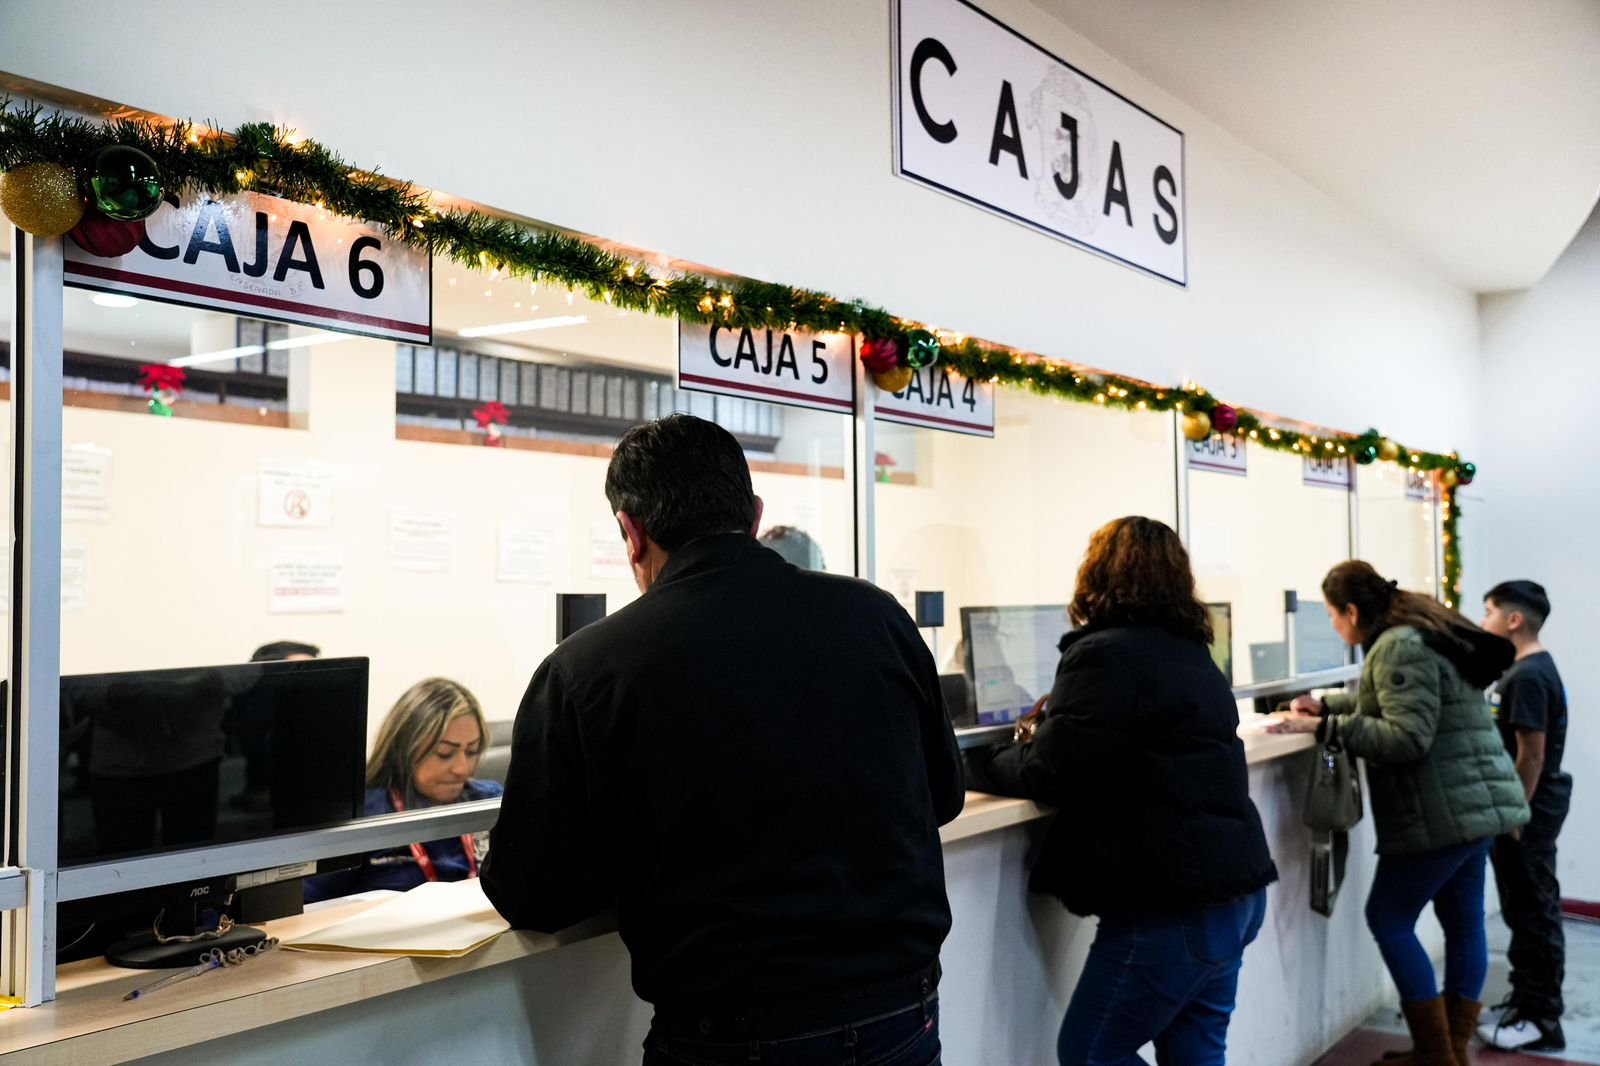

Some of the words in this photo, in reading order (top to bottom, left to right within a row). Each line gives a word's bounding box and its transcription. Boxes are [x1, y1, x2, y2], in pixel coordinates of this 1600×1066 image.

[910, 37, 1178, 245] CAJAS
[348, 236, 385, 299] 6
[709, 322, 800, 380] CAJA
[812, 340, 828, 384] 5
[892, 366, 954, 409] AJA
[962, 376, 976, 412] 4
[189, 885, 210, 897] AOC
